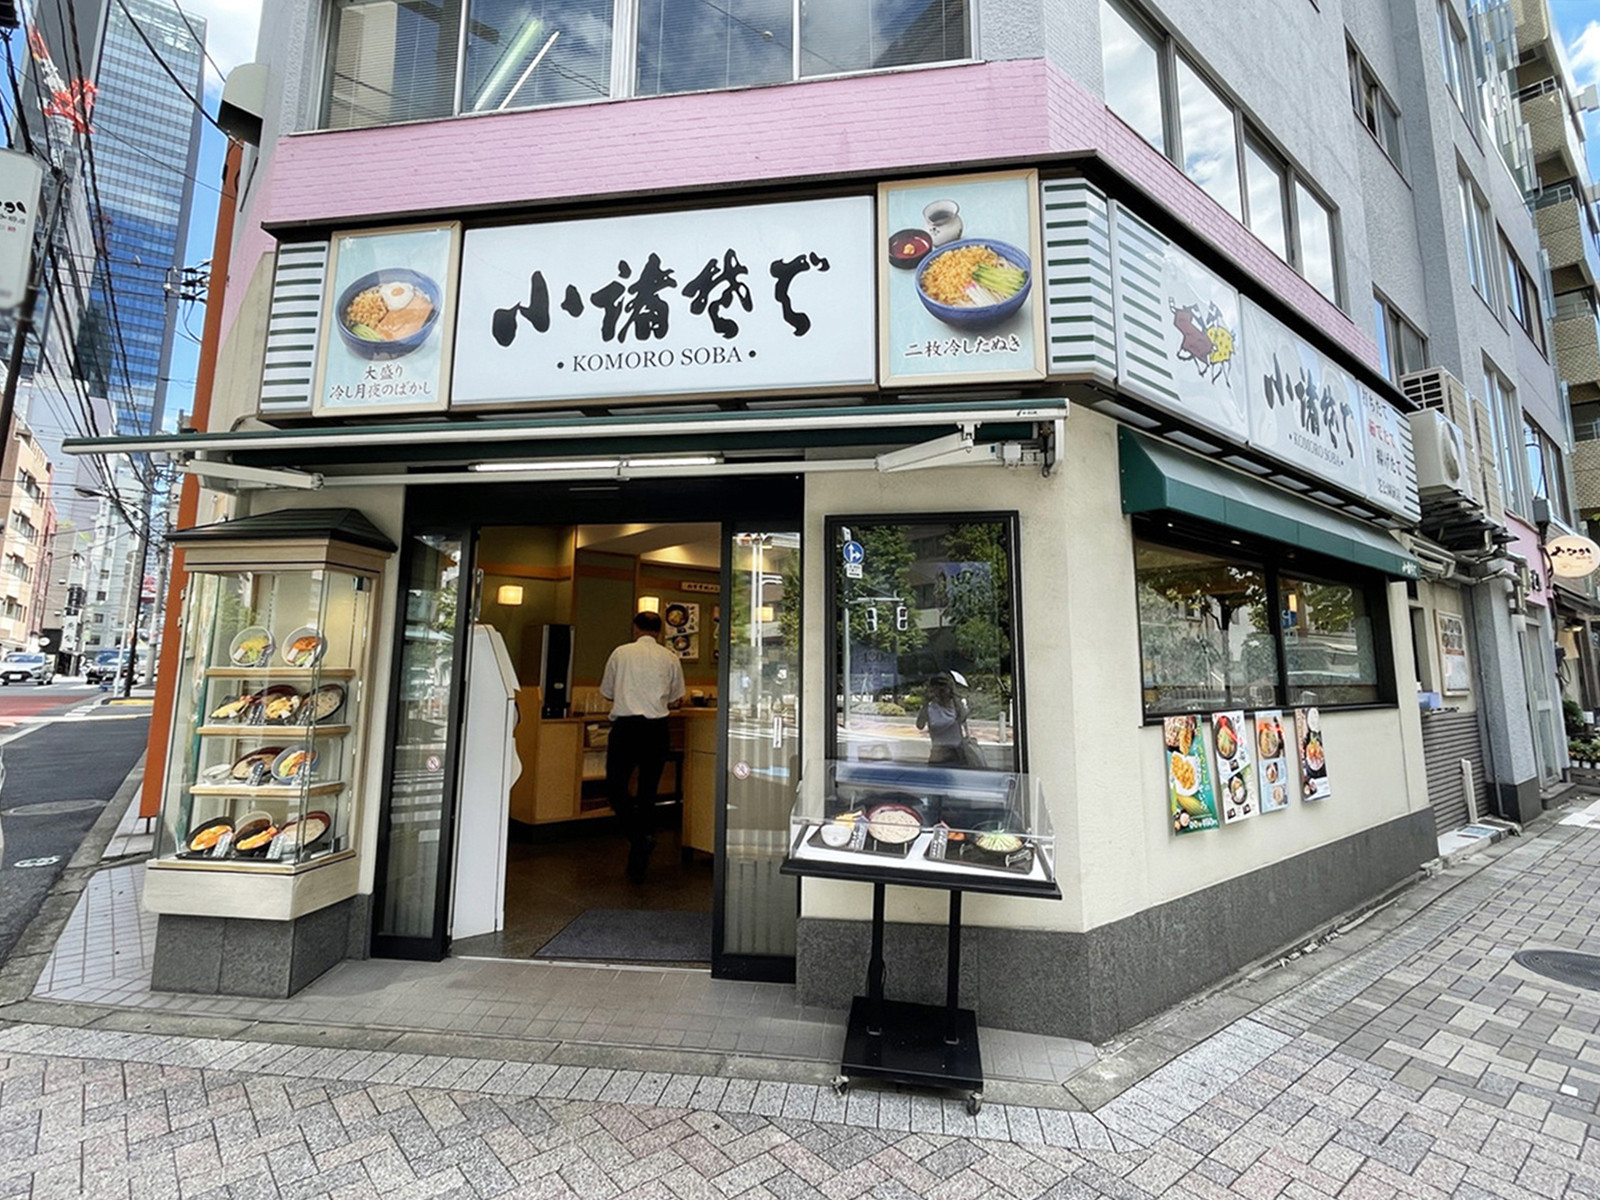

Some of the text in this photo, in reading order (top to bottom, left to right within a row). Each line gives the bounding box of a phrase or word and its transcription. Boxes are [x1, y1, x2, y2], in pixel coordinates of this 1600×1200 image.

[905, 335, 1020, 357] 二枚冷したぬき
[573, 346, 742, 372] KOMORO SOBA
[364, 364, 404, 380] 大盛り
[329, 381, 432, 400] 冷し月夜のばかし
